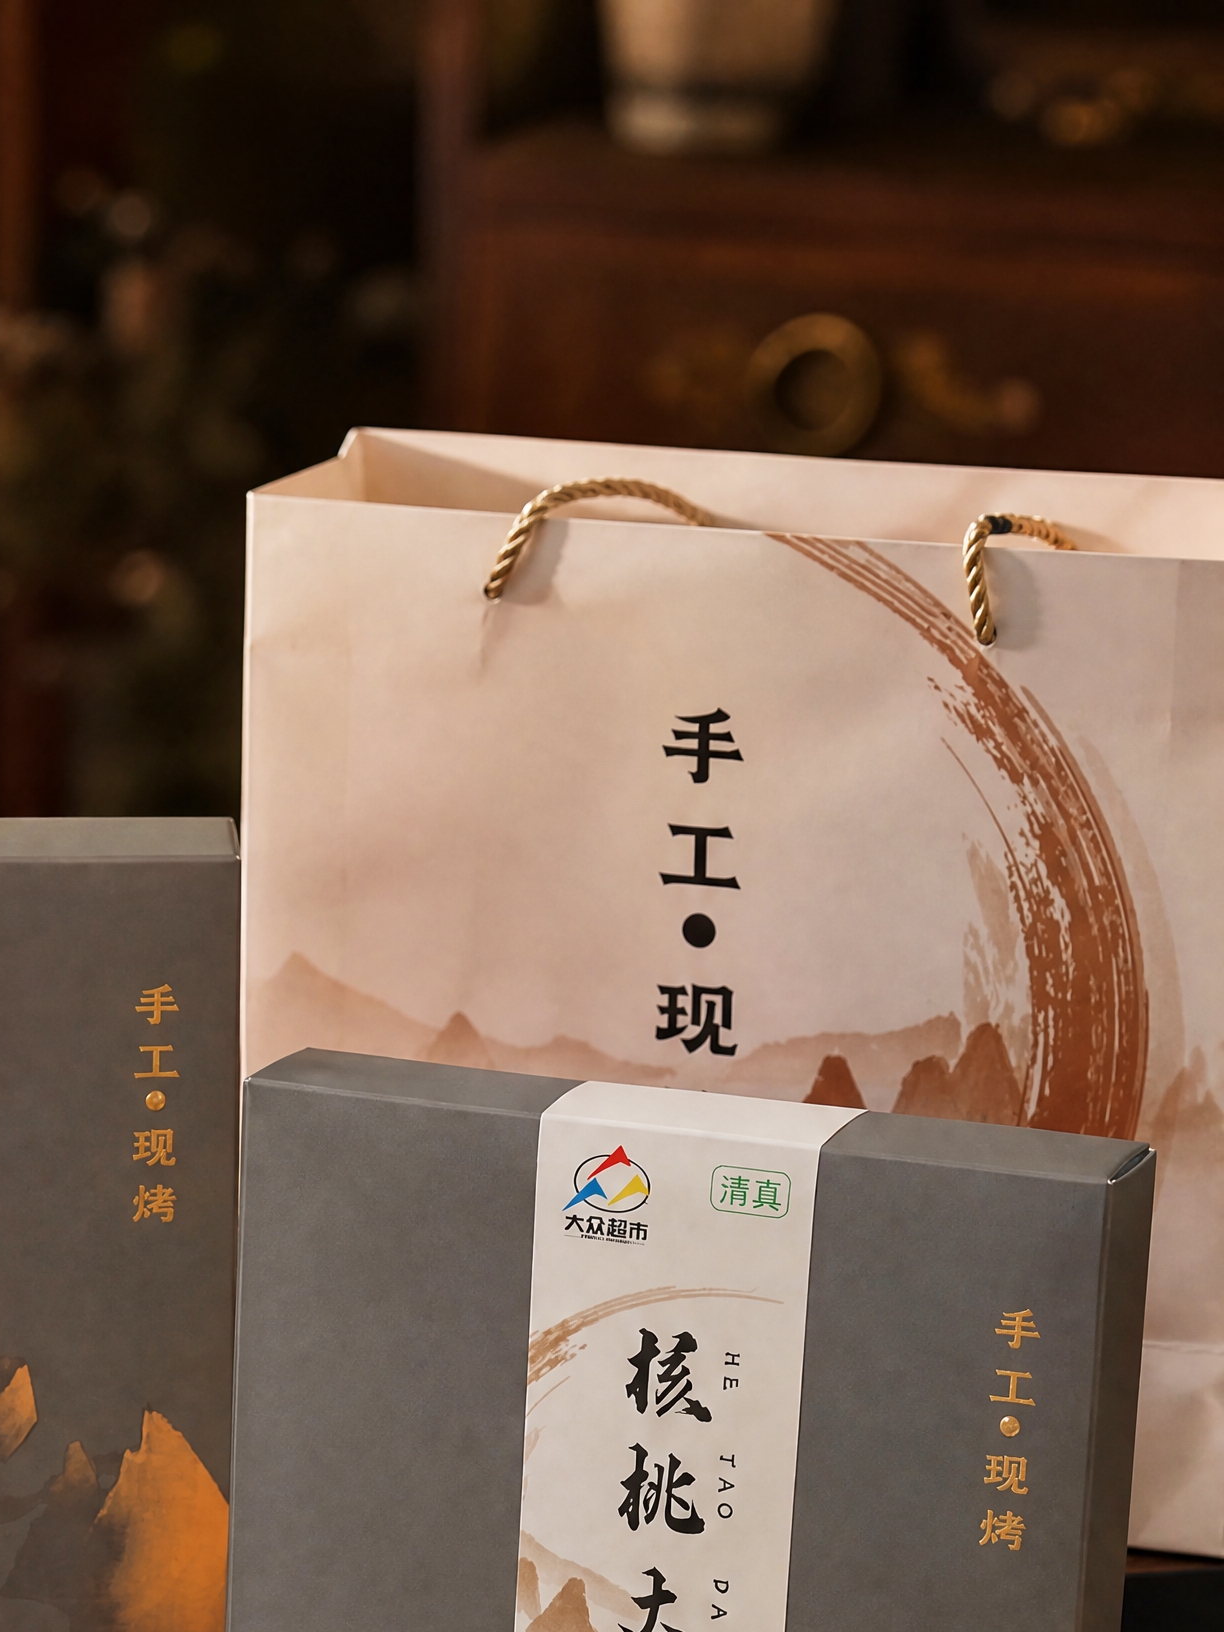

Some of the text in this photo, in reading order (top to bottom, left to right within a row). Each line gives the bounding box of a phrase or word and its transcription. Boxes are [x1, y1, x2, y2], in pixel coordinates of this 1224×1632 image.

[719, 1175, 782, 1212] 清真
[564, 1214, 649, 1241] 大众超市
[722, 1351, 741, 1391] HE
[717, 1454, 736, 1520] TAO
[710, 1579, 730, 1620] DA
